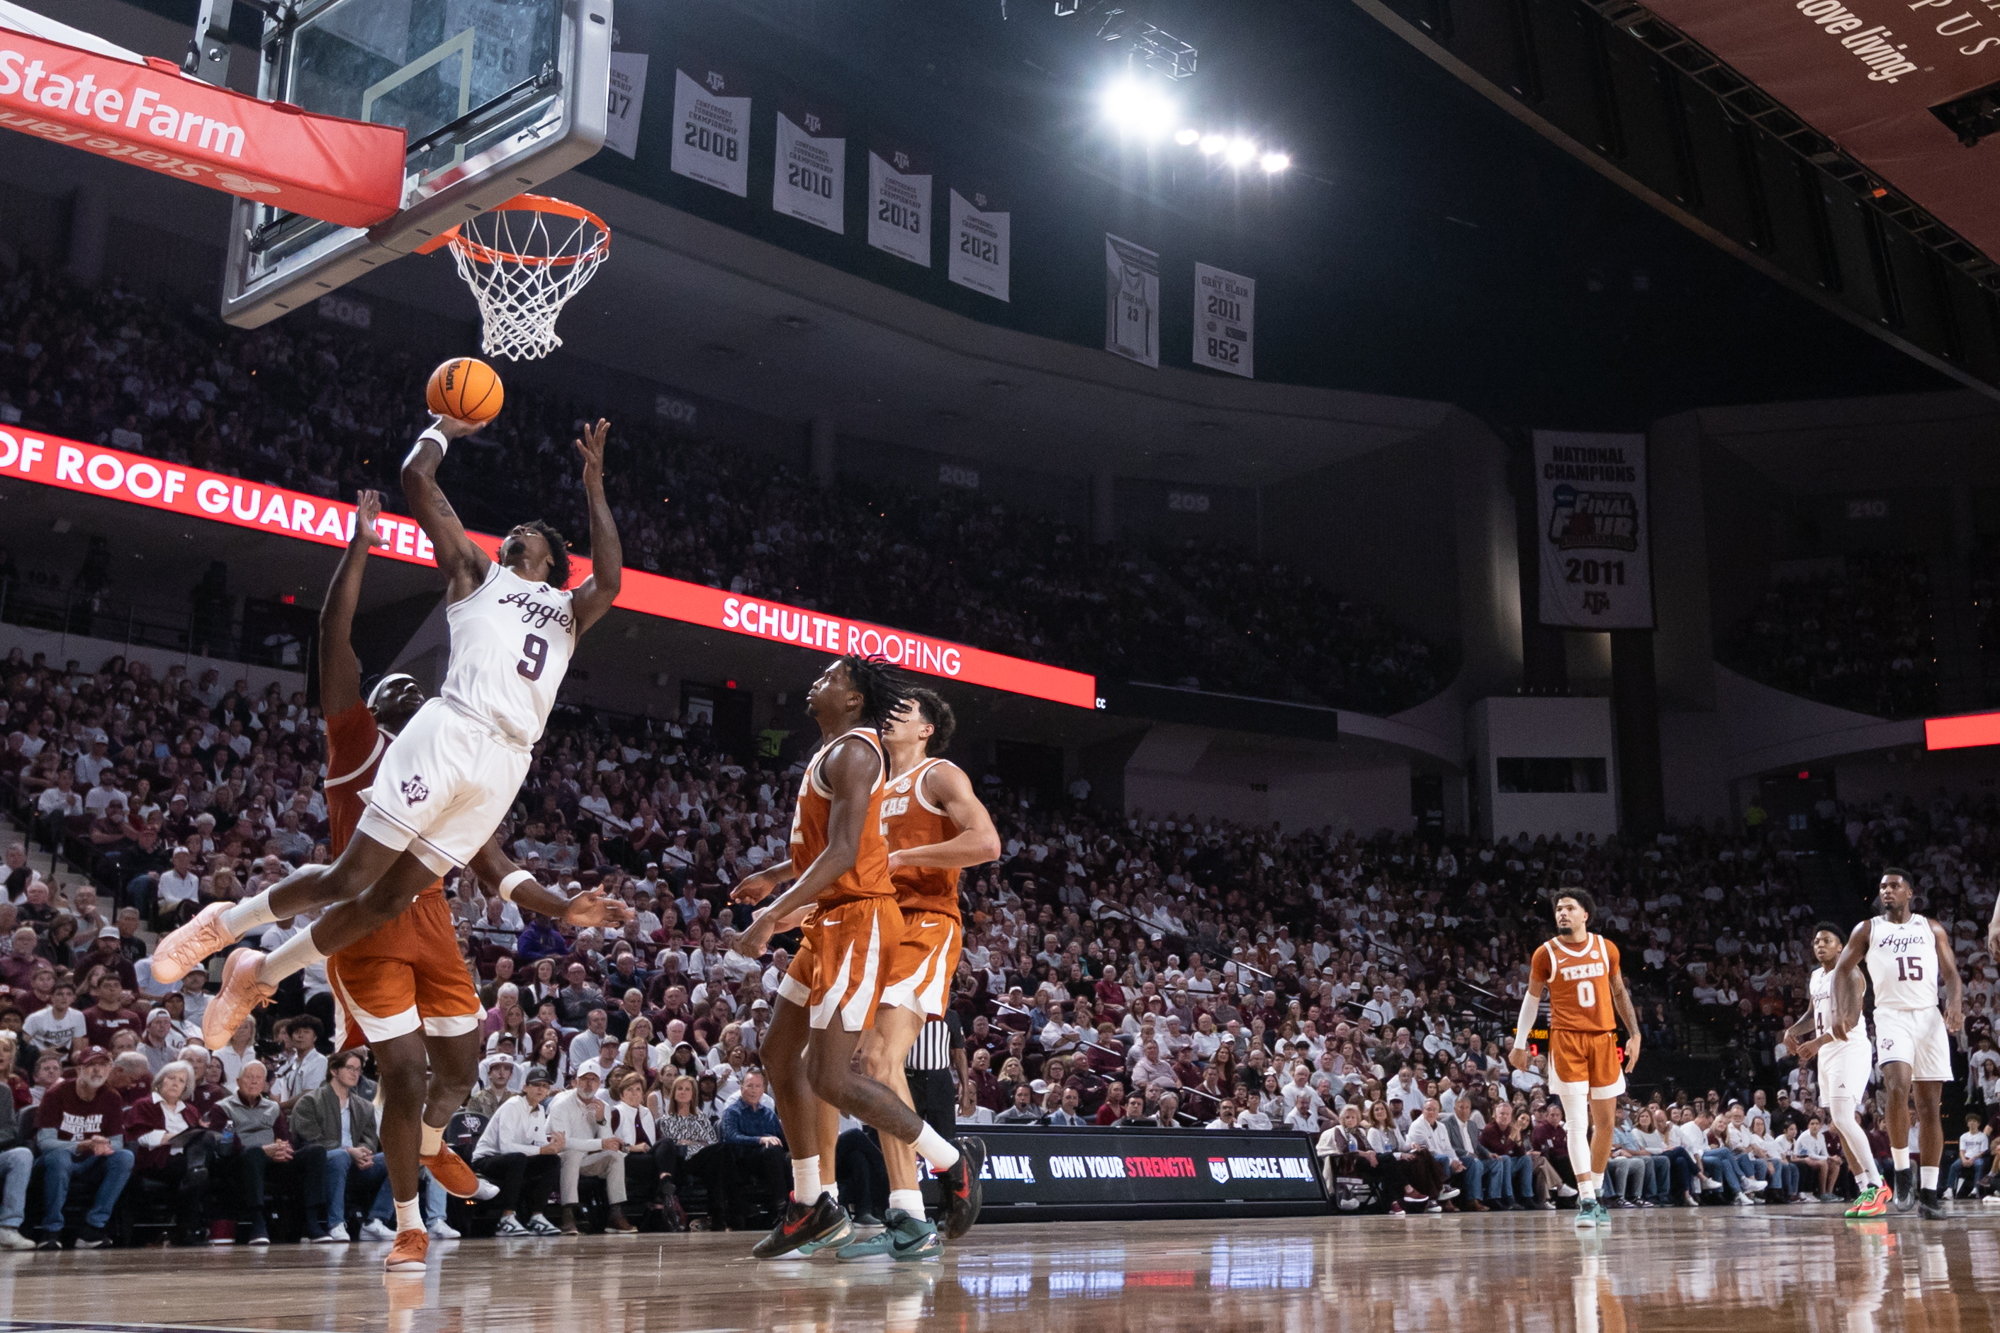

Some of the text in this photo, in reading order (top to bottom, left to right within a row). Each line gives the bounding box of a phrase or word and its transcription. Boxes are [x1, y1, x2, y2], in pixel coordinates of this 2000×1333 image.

[1841, 25, 1917, 84] living.
[684, 121, 739, 162] 2008
[788, 162, 832, 199] 2010
[878, 199, 921, 234] 2013
[960, 231, 999, 265] 2021
[1208, 295, 1241, 321] 2011
[1208, 337, 1239, 364] 852
[655, 395, 697, 422] 207
[1553, 446, 1625, 464] NATIONAL
[56, 445, 186, 503] ROOF
[1544, 463, 1635, 482] CHAMPIONS
[1167, 493, 1210, 513] 209
[1575, 493, 1633, 516] FINAL
[1848, 500, 1886, 520] 210
[1566, 558, 1625, 586] 2011
[722, 597, 961, 677] SCHULTE ROOFING
[516, 633, 549, 682] 9
[1879, 933, 1925, 953] Aggies
[1560, 962, 1605, 982] TEXAS
[1895, 956, 1923, 982] 15
[1577, 980, 1596, 1008] 0
[991, 1155, 1034, 1180] MILK
[1050, 1156, 1087, 1179] OWN
[1085, 1156, 1127, 1179] YOUR
[1125, 1156, 1197, 1178] STRENGTH
[1227, 1157, 1281, 1179] MUSCLE
[1279, 1157, 1313, 1179] MILK
